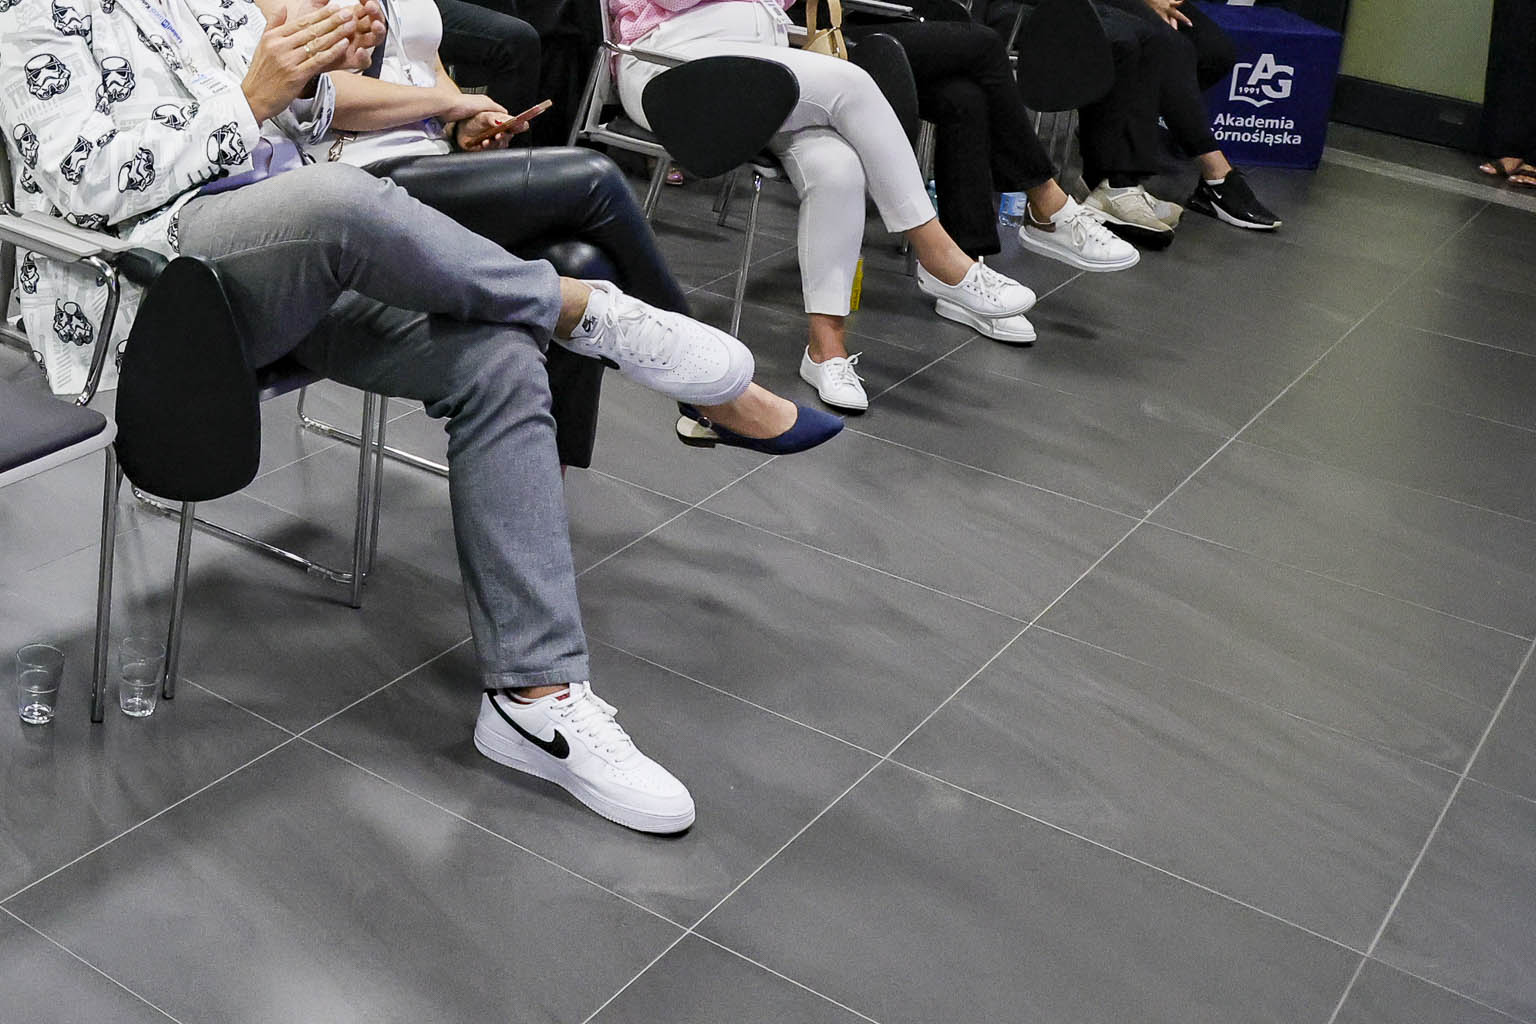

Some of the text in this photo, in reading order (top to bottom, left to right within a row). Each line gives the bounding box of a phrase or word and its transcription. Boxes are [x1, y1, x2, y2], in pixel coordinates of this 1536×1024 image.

[1247, 53, 1295, 99] AG
[1238, 86, 1260, 95] 1991
[1214, 113, 1295, 130] Akademia
